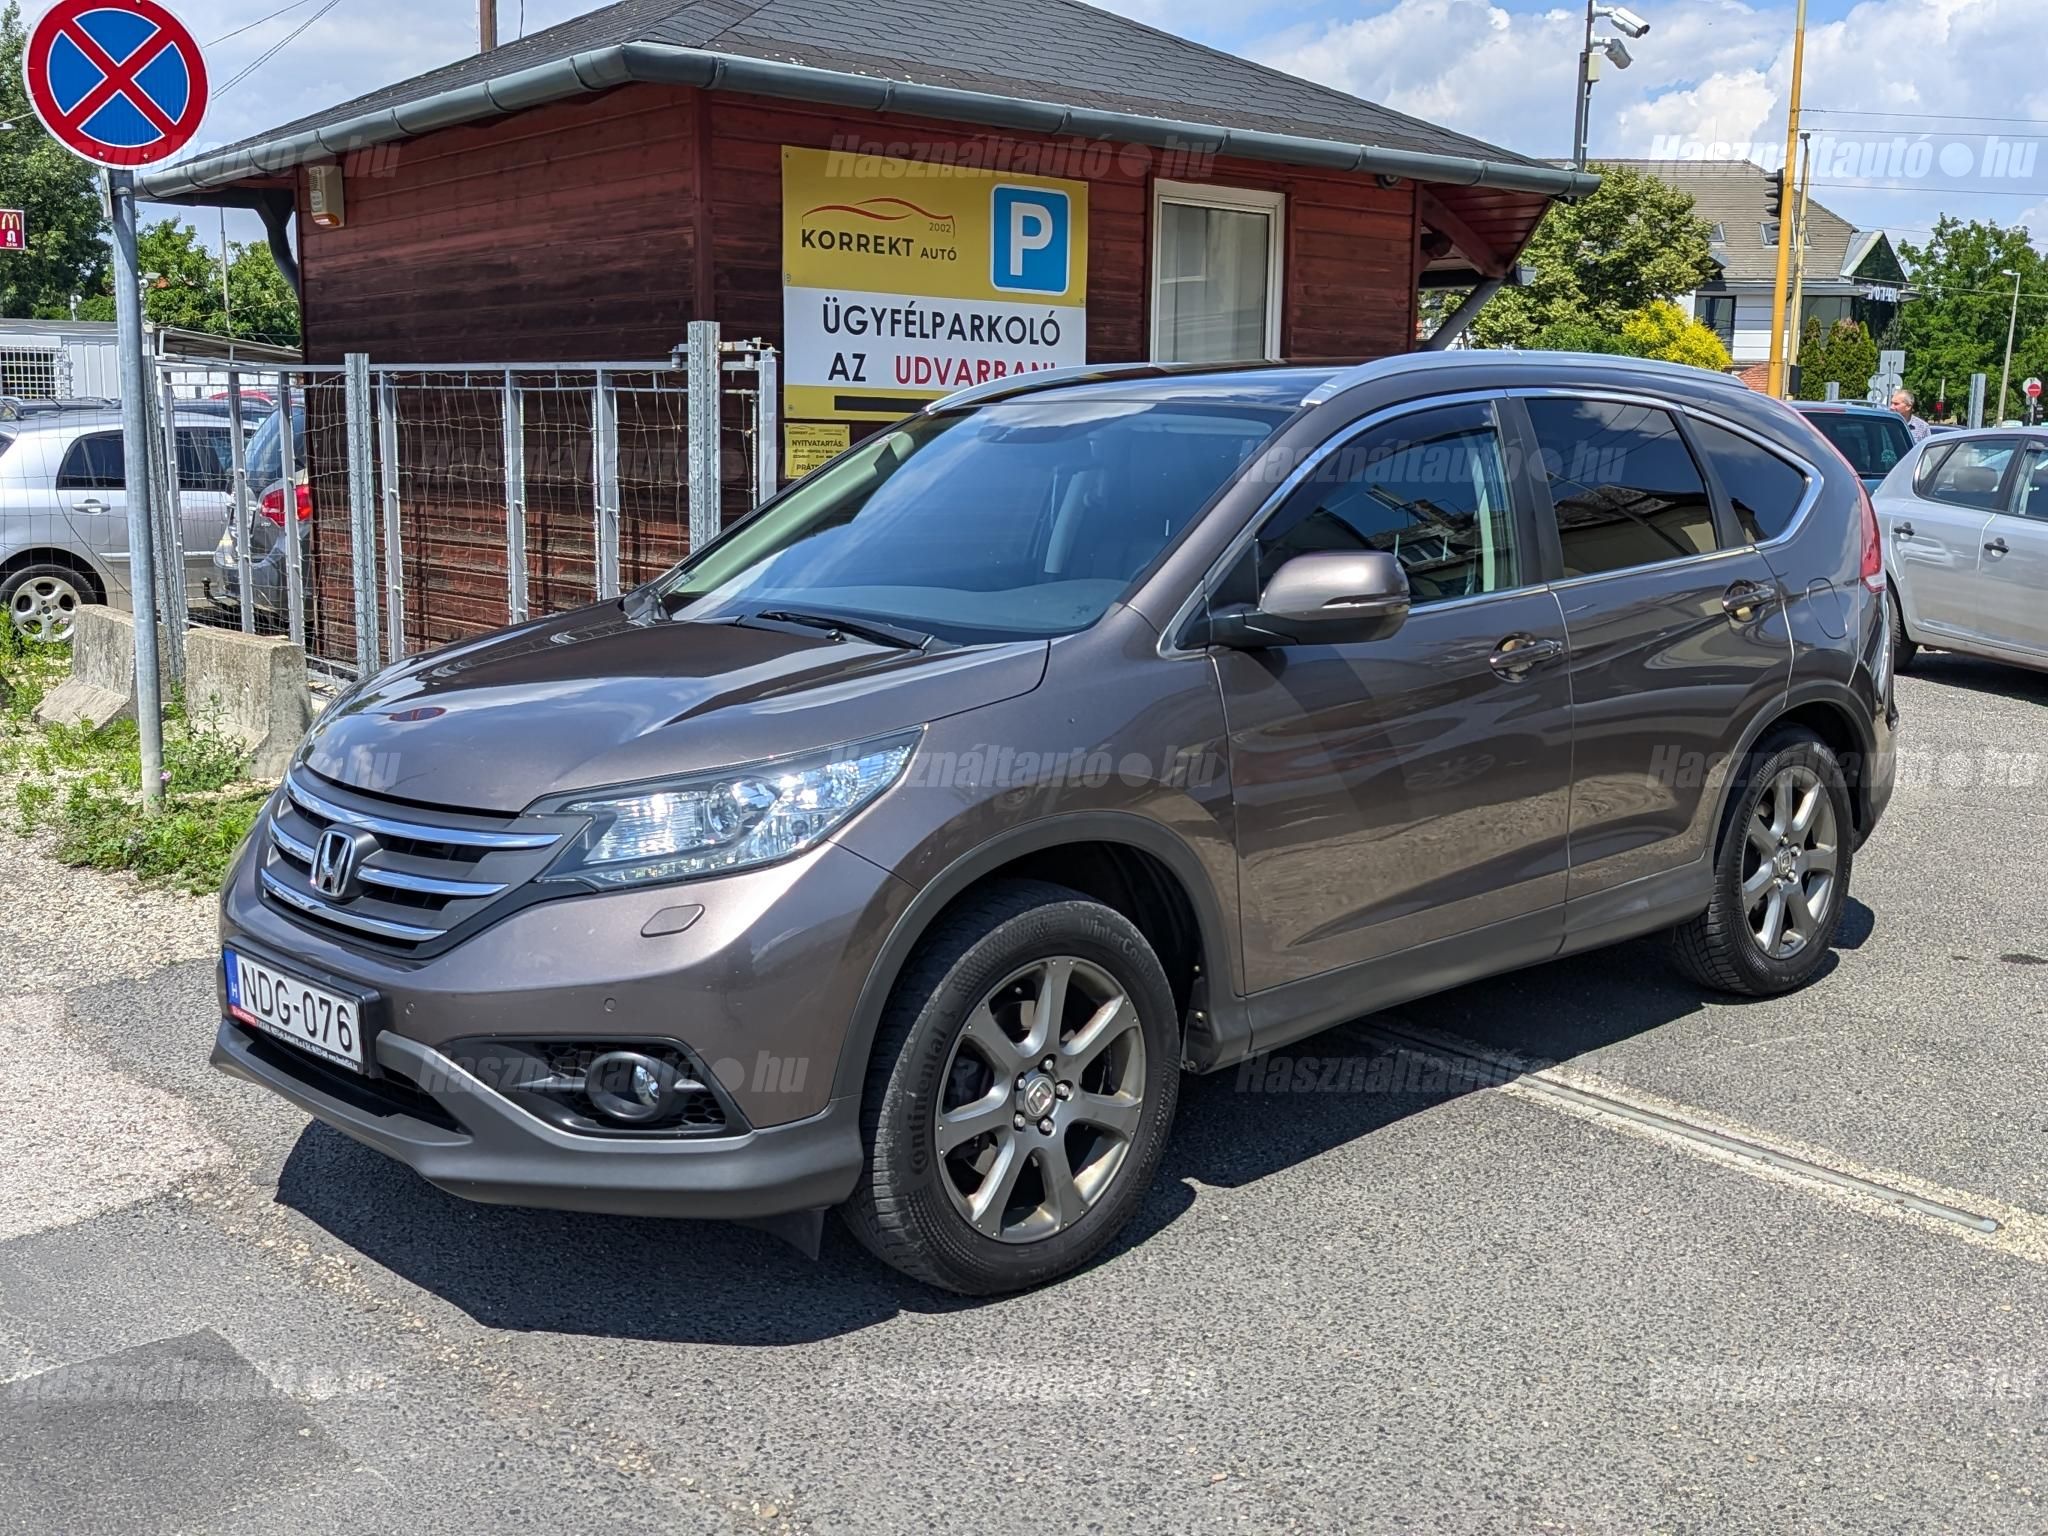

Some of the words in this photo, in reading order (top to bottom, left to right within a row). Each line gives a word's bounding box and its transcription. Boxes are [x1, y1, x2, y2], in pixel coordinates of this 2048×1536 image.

[801, 229, 914, 257] KORREKT
[920, 246, 957, 261] AUTÓ
[929, 222, 951, 233] 2002
[823, 297, 1060, 347] ÜGYFÉLPARKOLÓ
[828, 352, 866, 383] AZ
[895, 355, 1056, 387] UDVARB
[240, 961, 352, 1053] NDG-076
